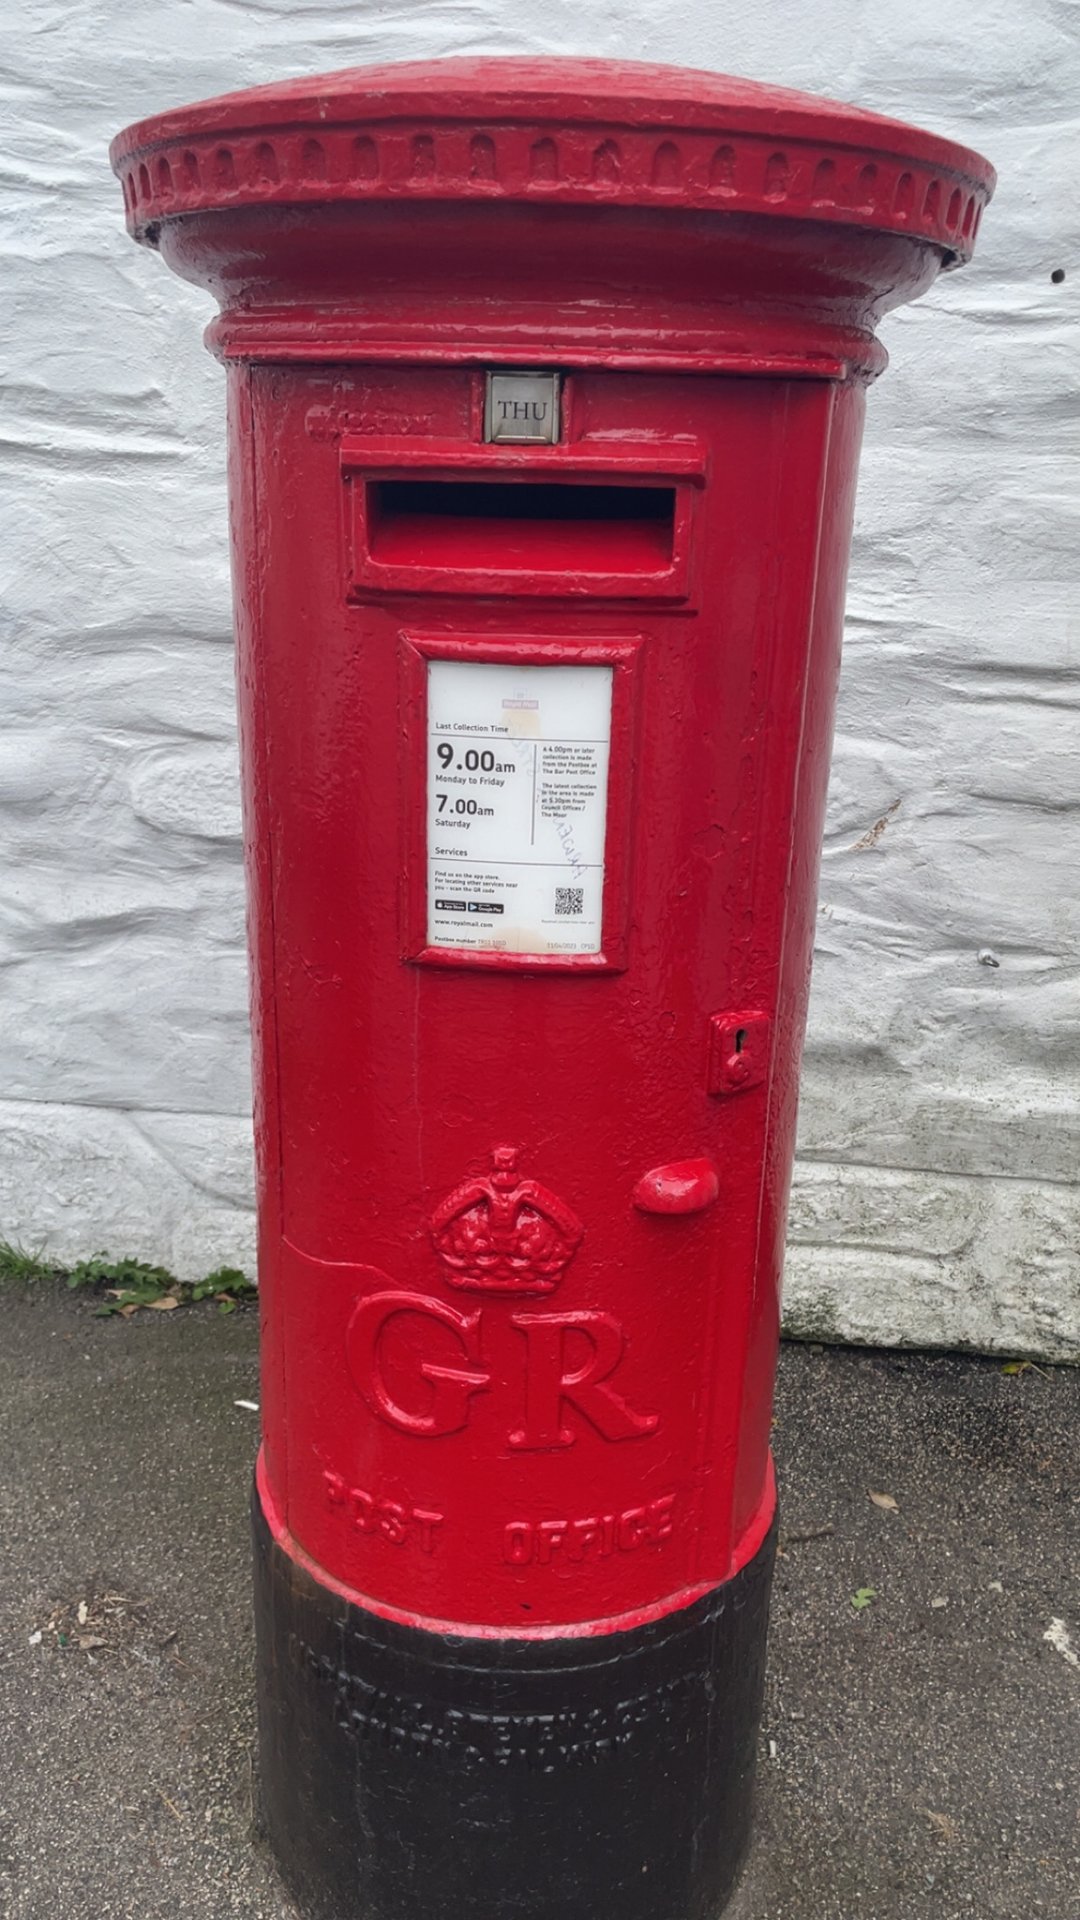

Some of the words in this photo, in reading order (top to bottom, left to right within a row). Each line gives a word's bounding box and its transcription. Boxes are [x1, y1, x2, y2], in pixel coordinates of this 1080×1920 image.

[498, 400, 548, 421] THU
[435, 722, 451, 730] Last
[453, 723, 489, 732] Collection
[490, 725, 509, 733] Time
[437, 743, 515, 772] 9.00am
[435, 774, 466, 785] Monday
[469, 777, 477, 785] to
[480, 777, 505, 788] Friday
[436, 794, 494, 816] 7.00am
[435, 818, 470, 830] Saturday
[435, 846, 468, 856] Services
[434, 919, 493, 928] www.royalmail.com
[323, 1470, 444, 1553] POST
[504, 1493, 676, 1565] OFFICE
